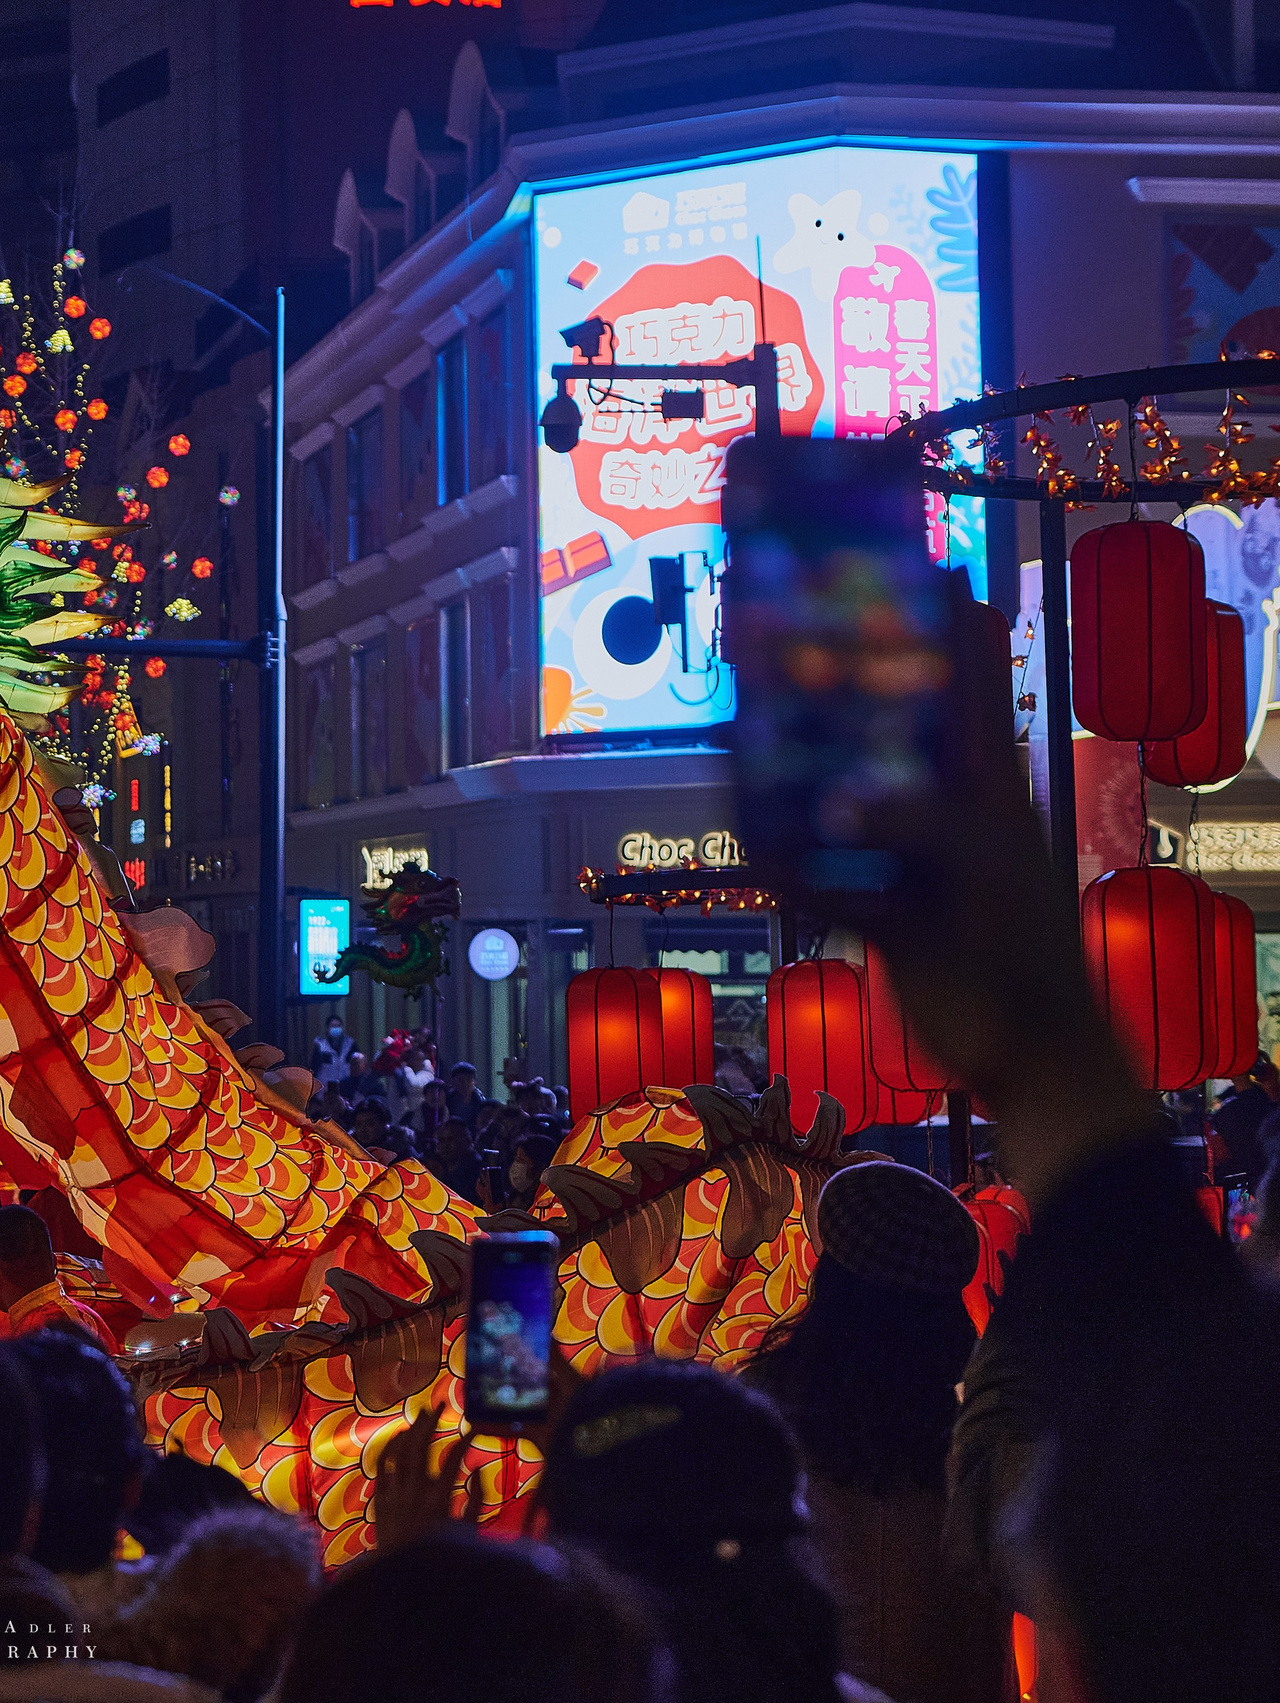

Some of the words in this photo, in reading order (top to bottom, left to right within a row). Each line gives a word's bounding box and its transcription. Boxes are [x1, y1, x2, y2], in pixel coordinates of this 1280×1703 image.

[619, 301, 751, 363] 巧克力
[840, 296, 892, 439] 敬请
[618, 832, 695, 868] Choc
[699, 830, 749, 867] Ch
